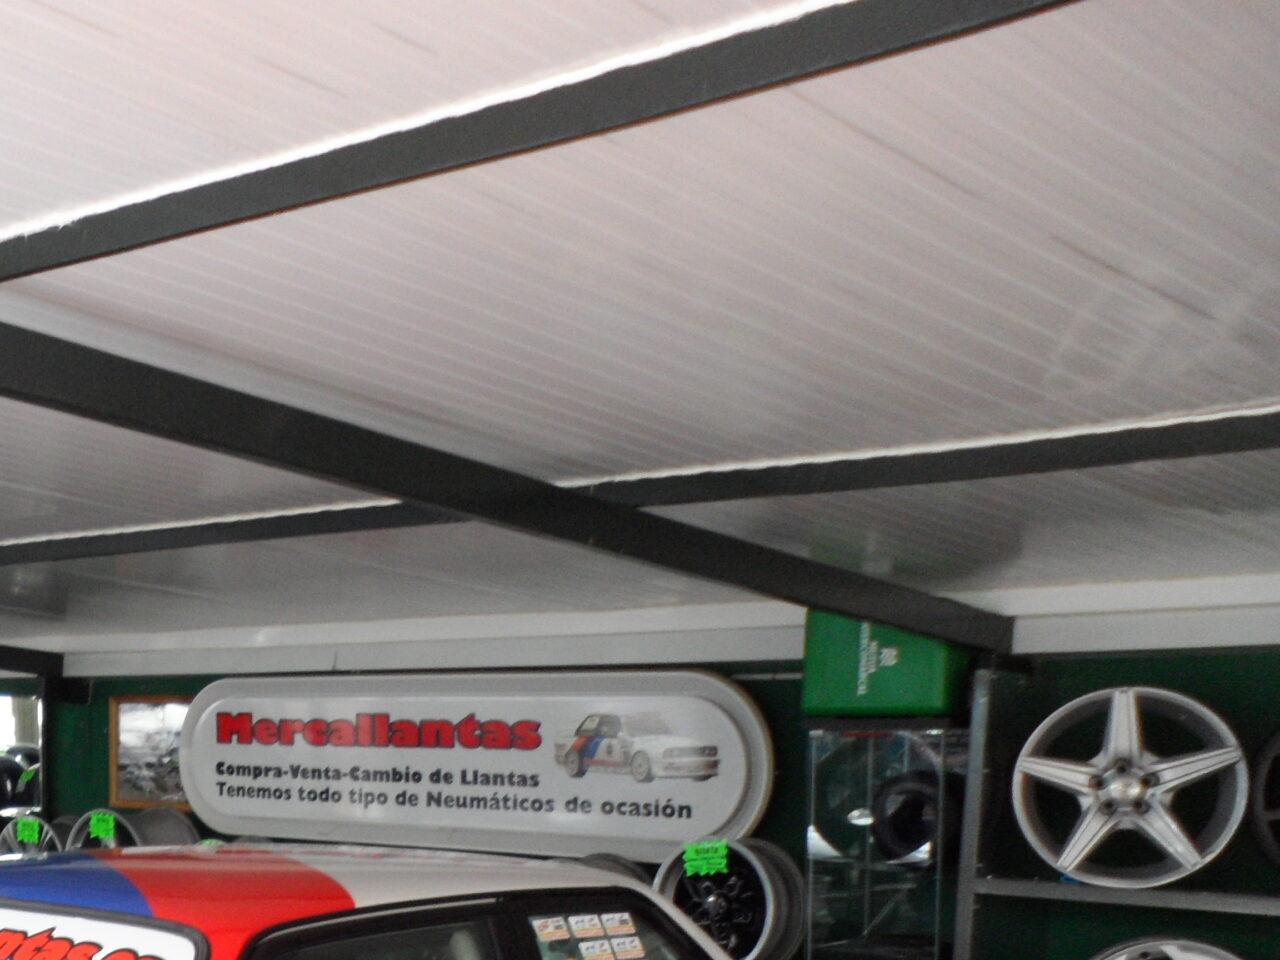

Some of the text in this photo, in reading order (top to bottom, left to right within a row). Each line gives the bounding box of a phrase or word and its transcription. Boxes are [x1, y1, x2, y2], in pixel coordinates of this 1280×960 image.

[216, 711, 542, 750] Mercallantas
[215, 761, 540, 787] Compra-Venta-Cambio de Llantas
[216, 782, 692, 819] Tenemos todo tipo de Neumáticos de ocasión
